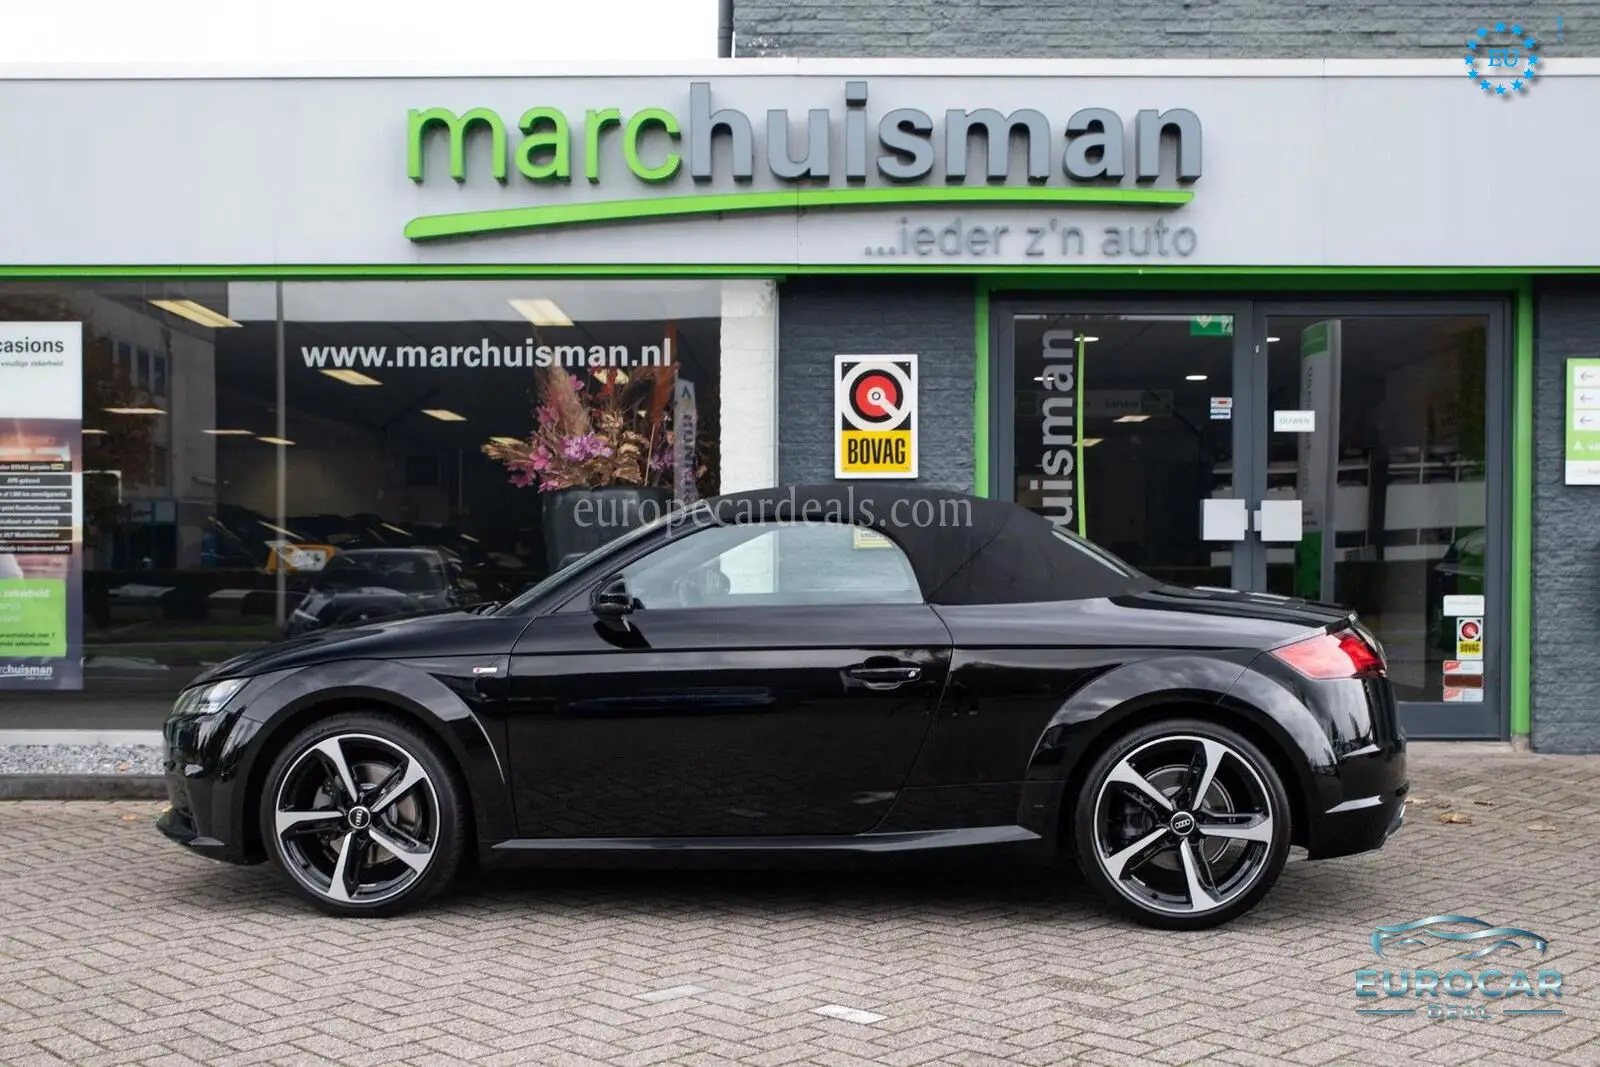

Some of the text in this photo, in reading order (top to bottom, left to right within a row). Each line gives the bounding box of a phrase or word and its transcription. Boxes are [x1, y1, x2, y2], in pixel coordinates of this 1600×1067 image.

[406, 82, 1203, 186] marchuisman
[1025, 218, 1083, 257] z'n
[1101, 221, 1198, 257] auto
[0, 336, 64, 353] asions
[301, 337, 671, 368] www.marchuisman.nl
[848, 438, 906, 465] BOVAG
